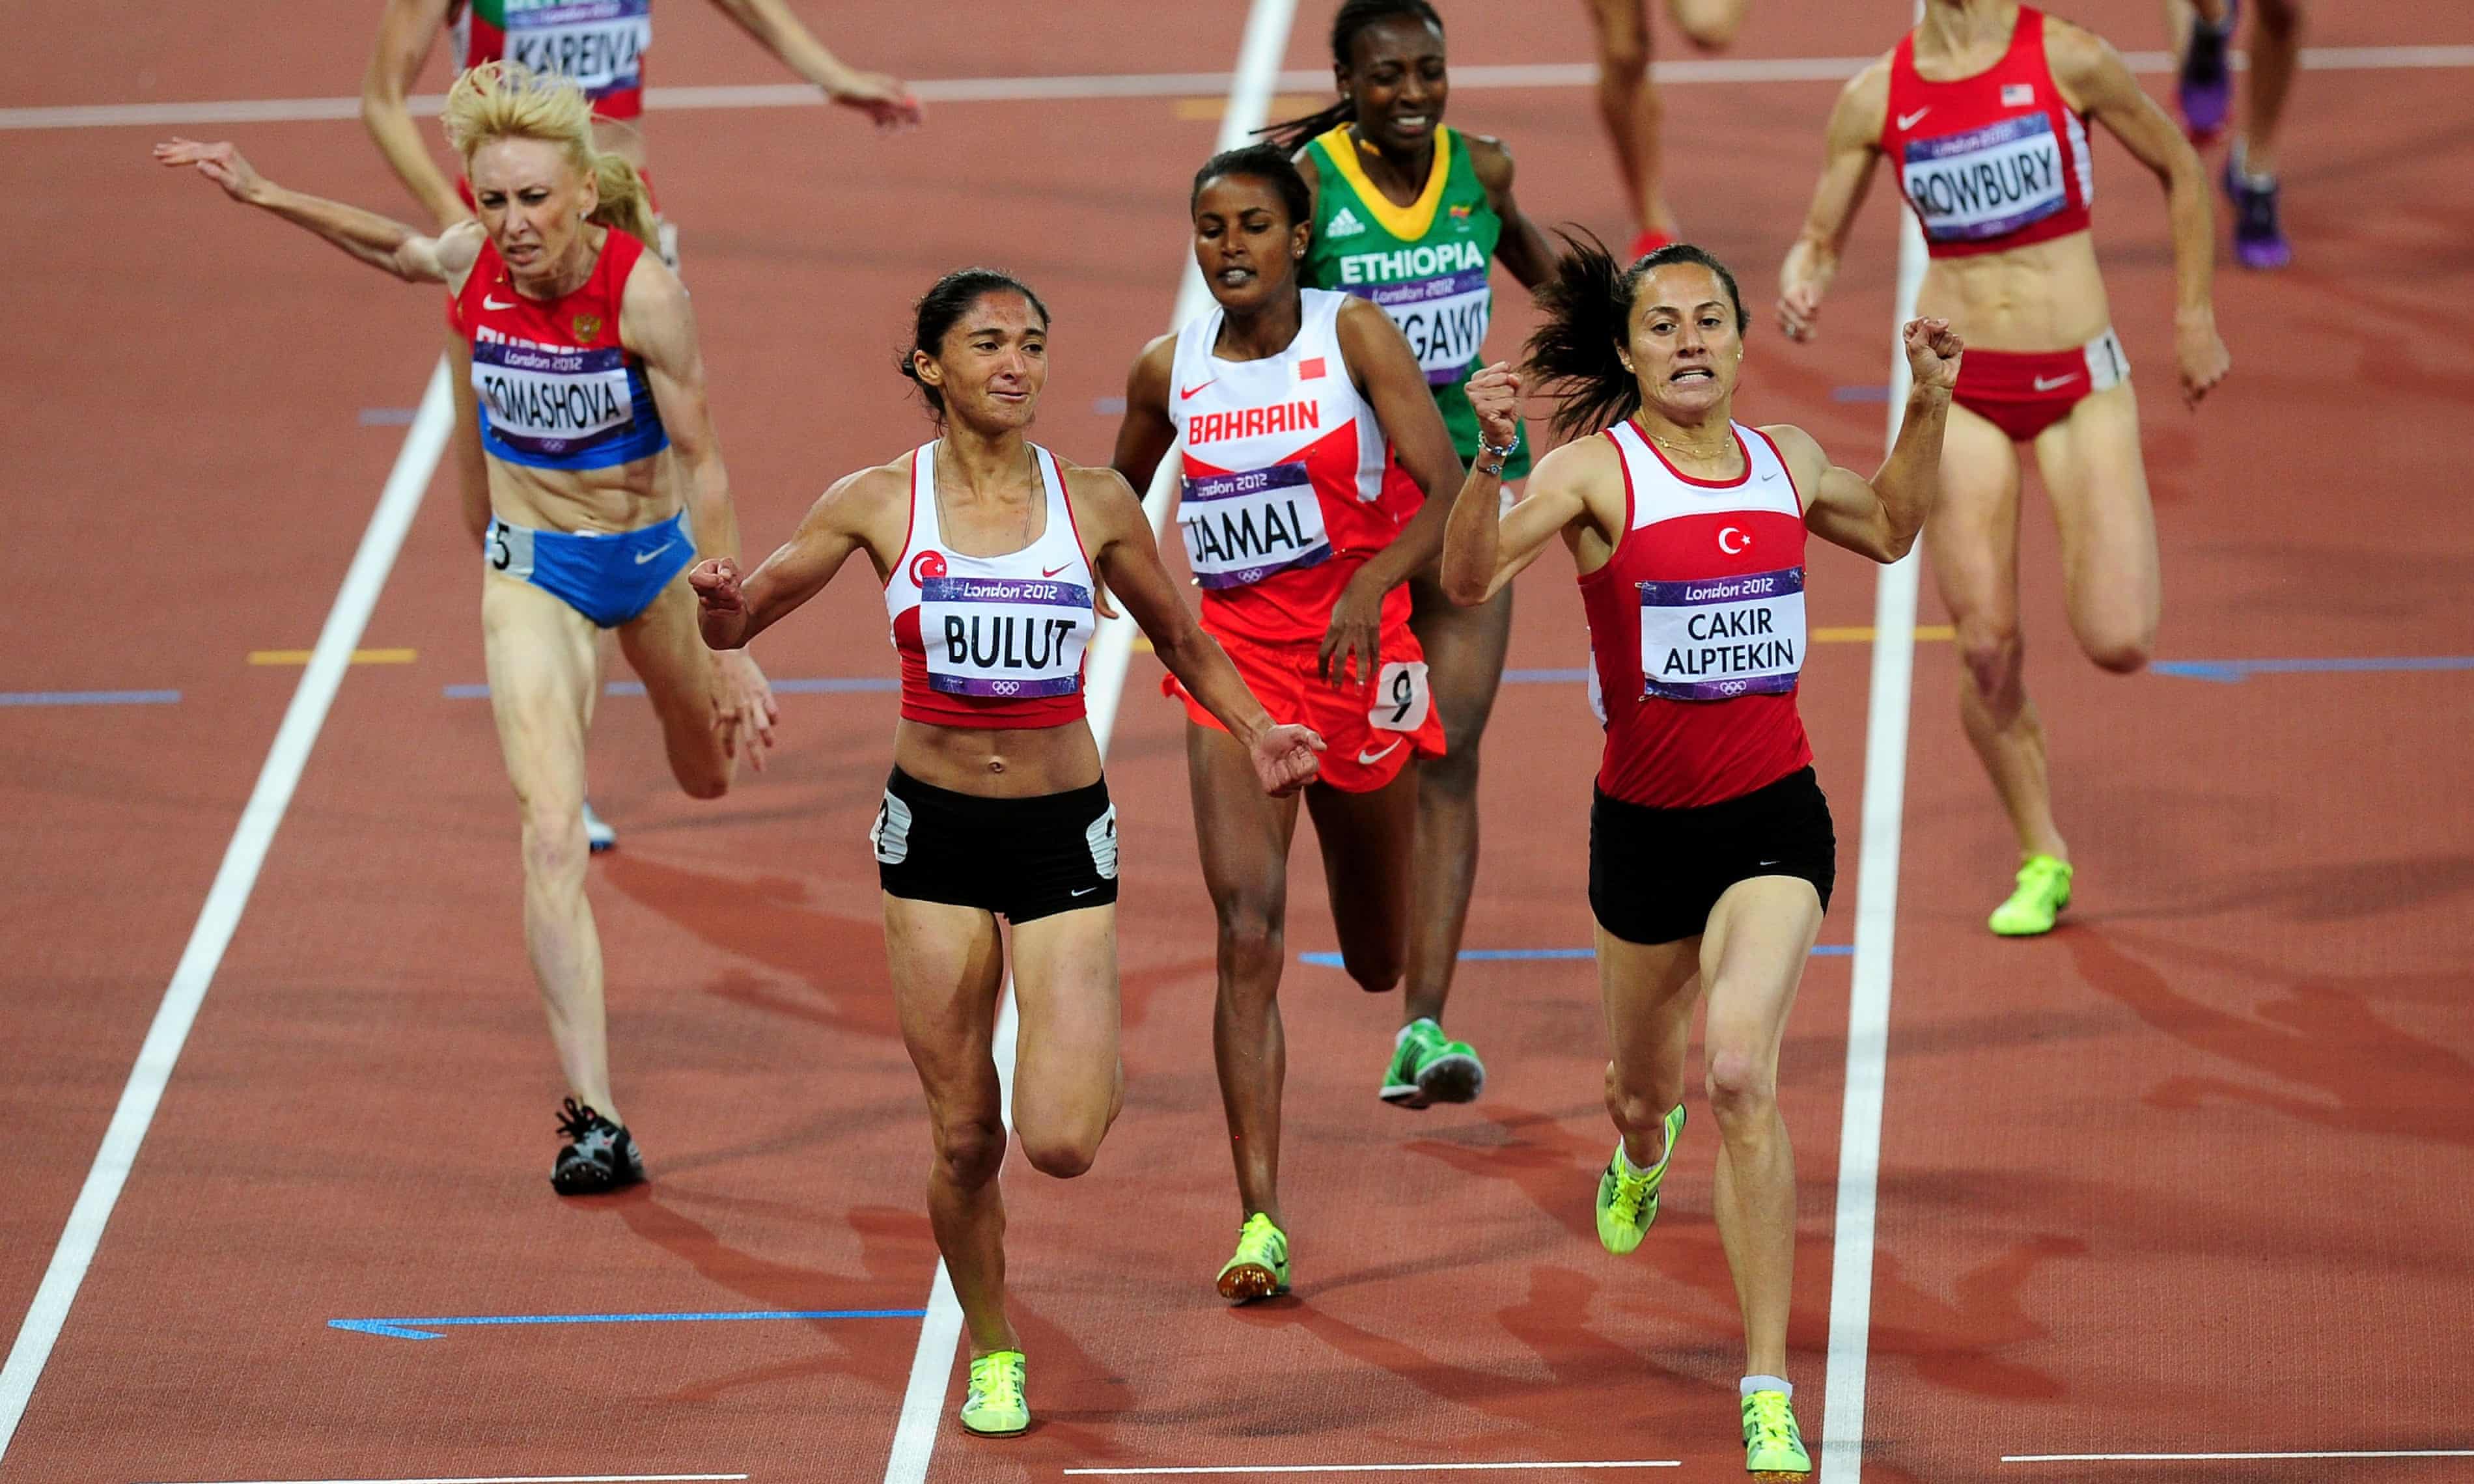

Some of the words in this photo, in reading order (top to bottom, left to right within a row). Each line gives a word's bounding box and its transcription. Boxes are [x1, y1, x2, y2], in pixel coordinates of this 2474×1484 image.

[1912, 146, 2051, 215] ROWBURY
[1340, 240, 1485, 284] ETHIOPIA
[1395, 301, 1482, 362] GAWI
[505, 349, 550, 369] London
[553, 356, 583, 370] 2012
[484, 376, 620, 429] TOMASHOVA
[1188, 398, 1320, 445] BAHRAIN
[1236, 473, 1268, 491] 2012
[493, 522, 510, 570] 5
[1189, 499, 1313, 563] JAMAL
[963, 583, 1020, 599] London
[1023, 584, 1058, 600] 2012
[1686, 583, 1739, 601] London
[1742, 577, 1774, 595] 2012
[944, 615, 1077, 670] BULUT
[1688, 608, 1773, 640] CAKIR
[1663, 639, 1794, 675] ALPTEKIN
[1391, 670, 1412, 723] 9
